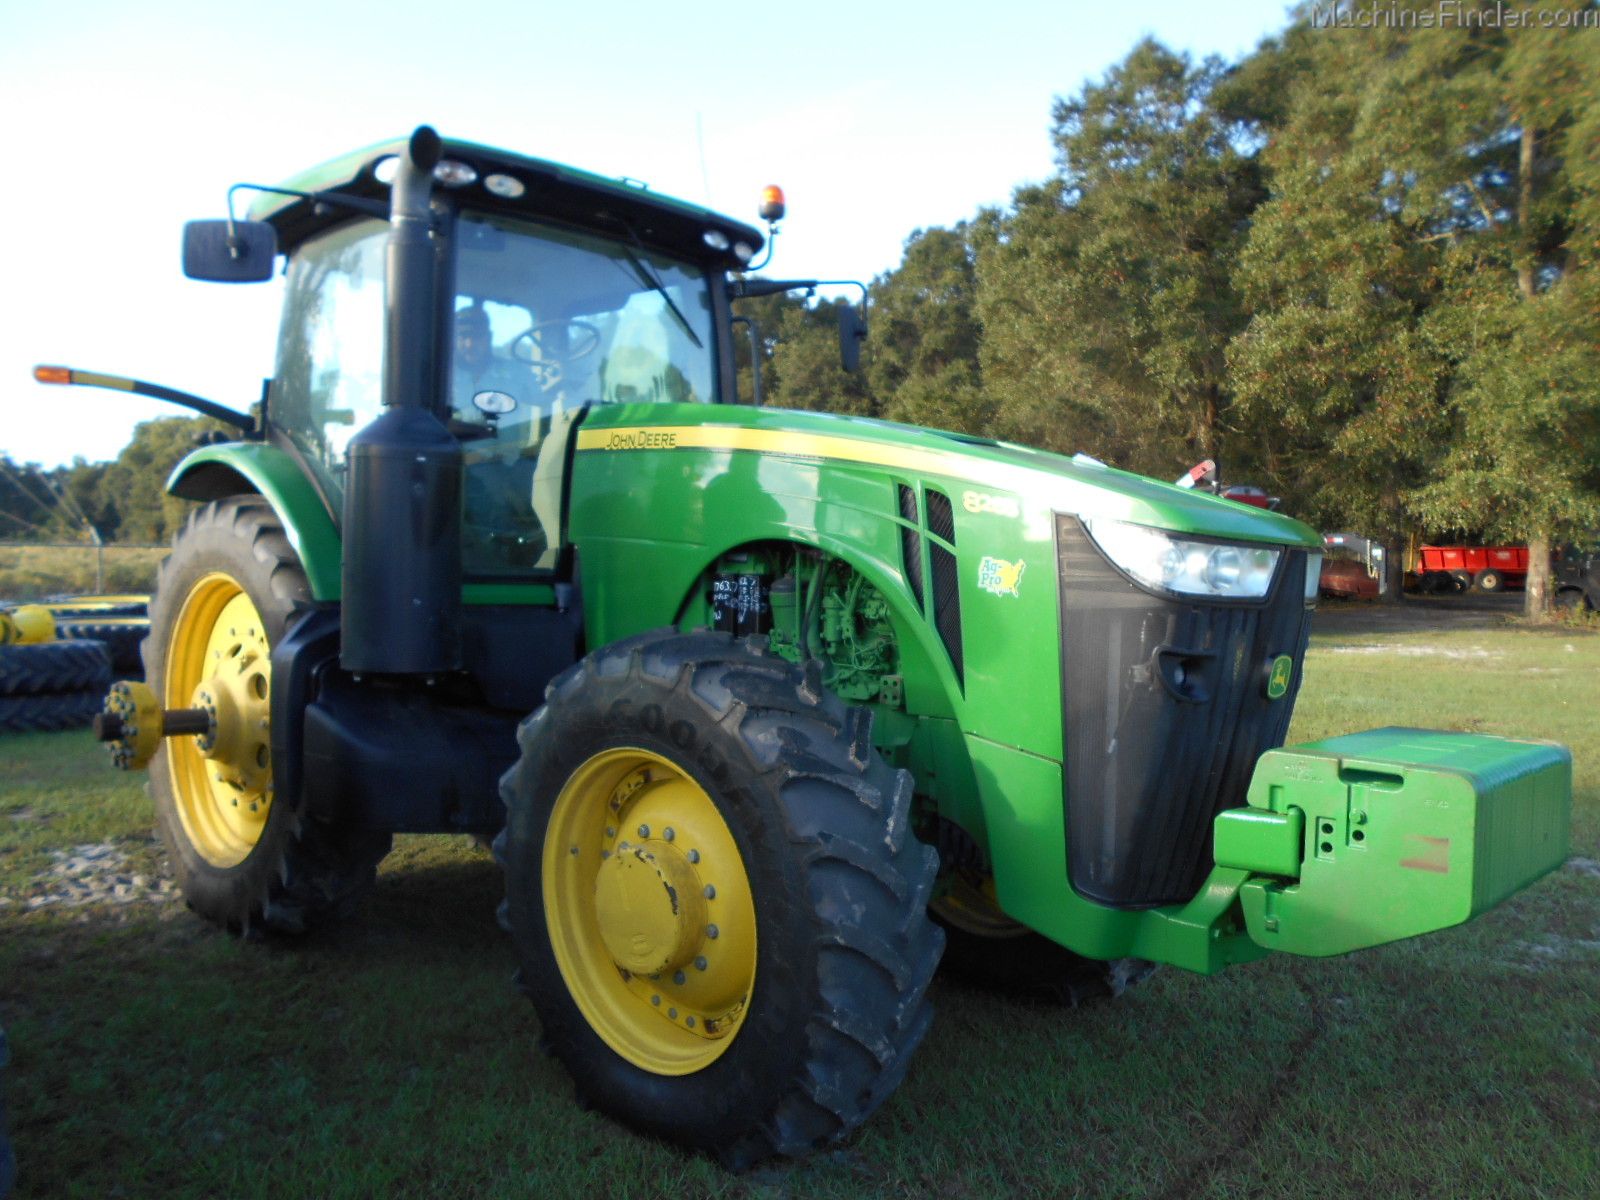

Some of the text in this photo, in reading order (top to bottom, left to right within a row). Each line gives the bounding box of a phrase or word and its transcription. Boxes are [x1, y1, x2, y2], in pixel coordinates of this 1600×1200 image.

[606, 430, 677, 448] JOHN DEERE
[980, 573, 1002, 585] Pro
